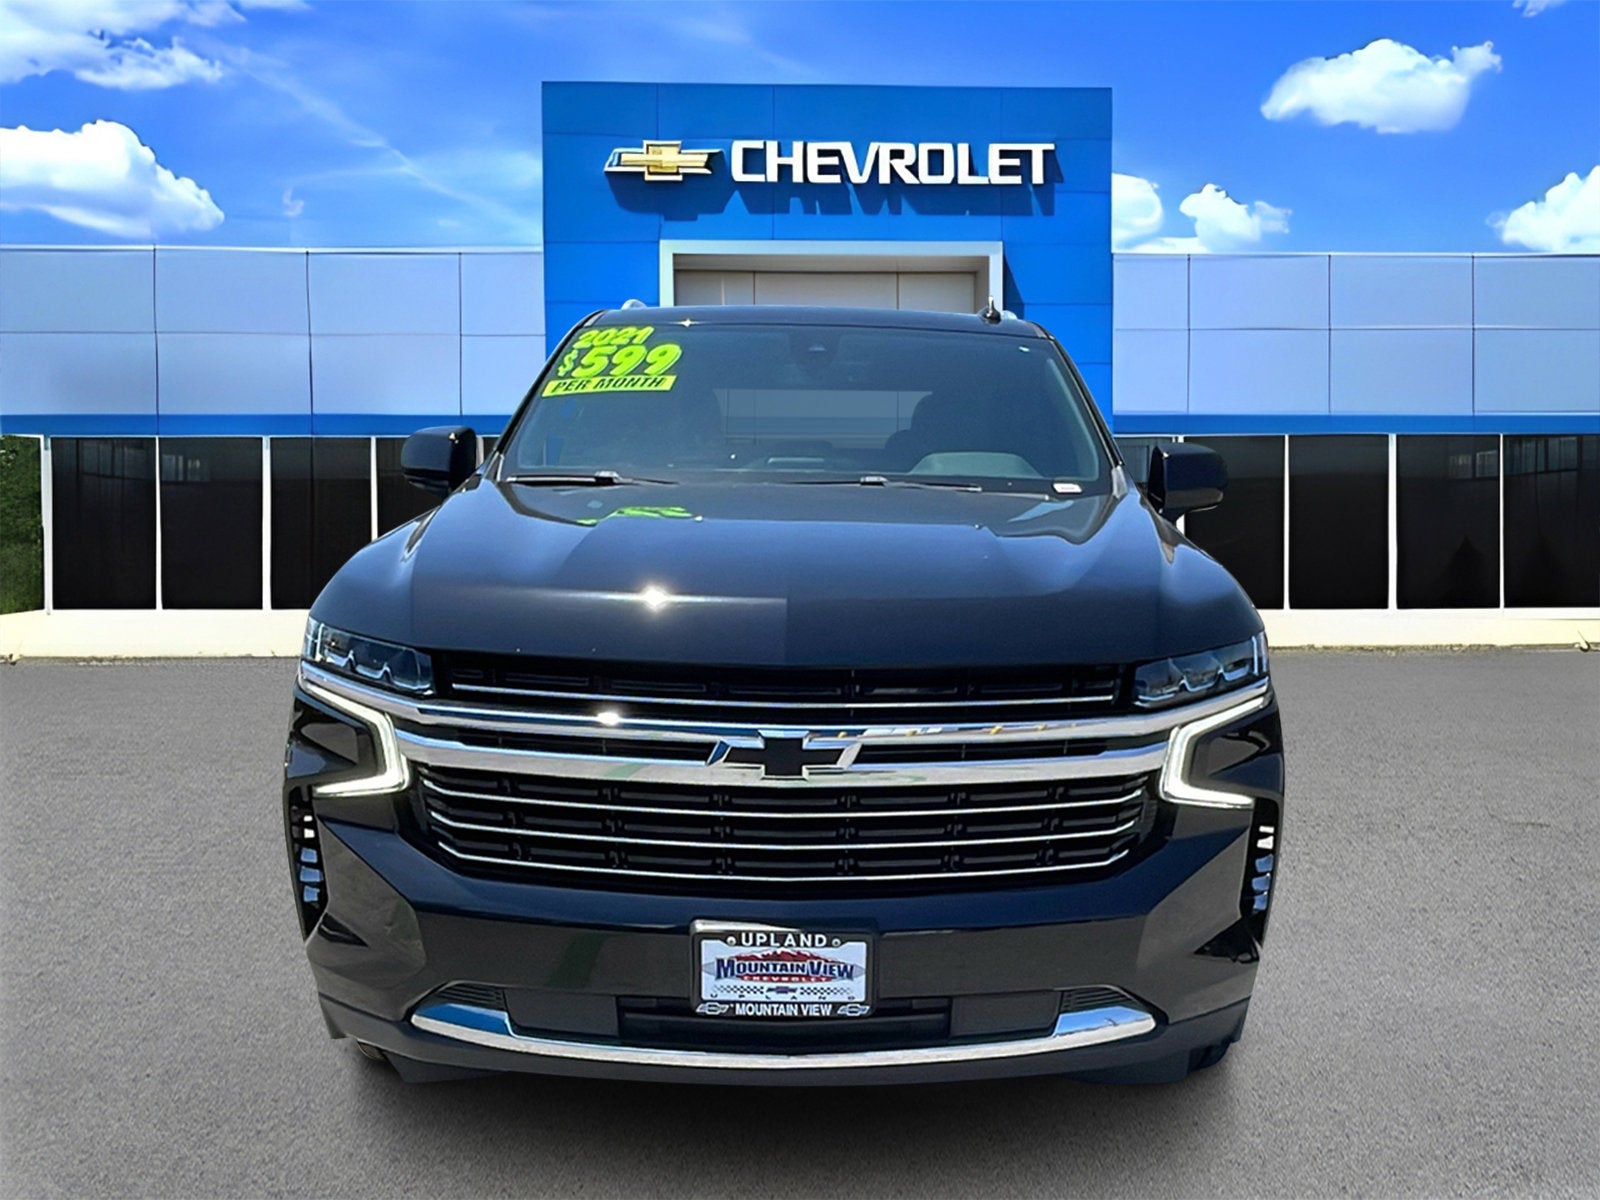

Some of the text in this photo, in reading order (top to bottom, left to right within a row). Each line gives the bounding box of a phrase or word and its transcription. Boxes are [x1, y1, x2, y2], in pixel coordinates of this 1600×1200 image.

[731, 140, 1055, 185] CHEVROLET
[573, 326, 654, 348] 2021
[558, 343, 682, 378] $599
[551, 378, 665, 393] PER MONTH
[741, 932, 827, 947] UPLAND
[735, 1003, 832, 1016] MOUNTAIN VIEW
